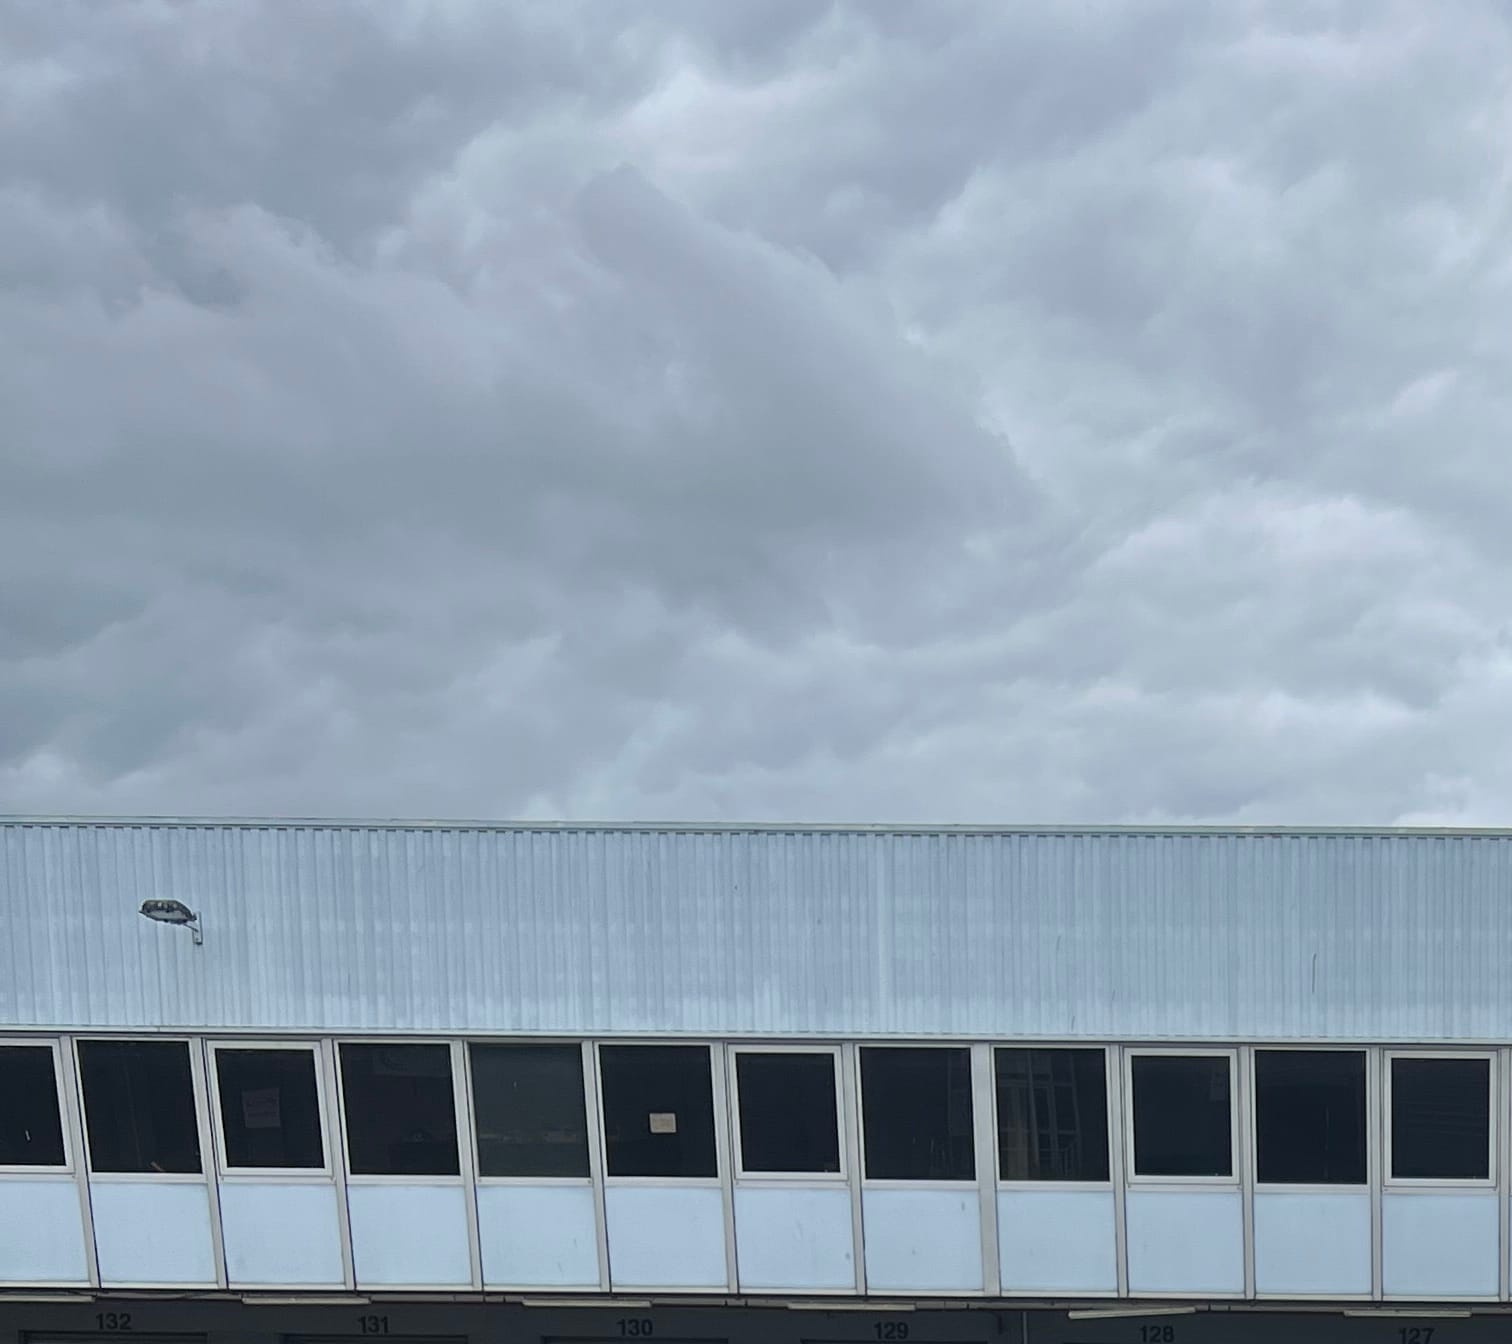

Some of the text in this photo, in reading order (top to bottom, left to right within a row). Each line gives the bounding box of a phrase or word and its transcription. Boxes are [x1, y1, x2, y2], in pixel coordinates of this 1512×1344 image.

[96, 1313, 131, 1330] 132
[358, 1316, 389, 1333] 131
[617, 1319, 653, 1336] 130
[874, 1322, 909, 1339] 129
[1140, 1325, 1175, 1343] 128
[1398, 1328, 1435, 1344] 127
